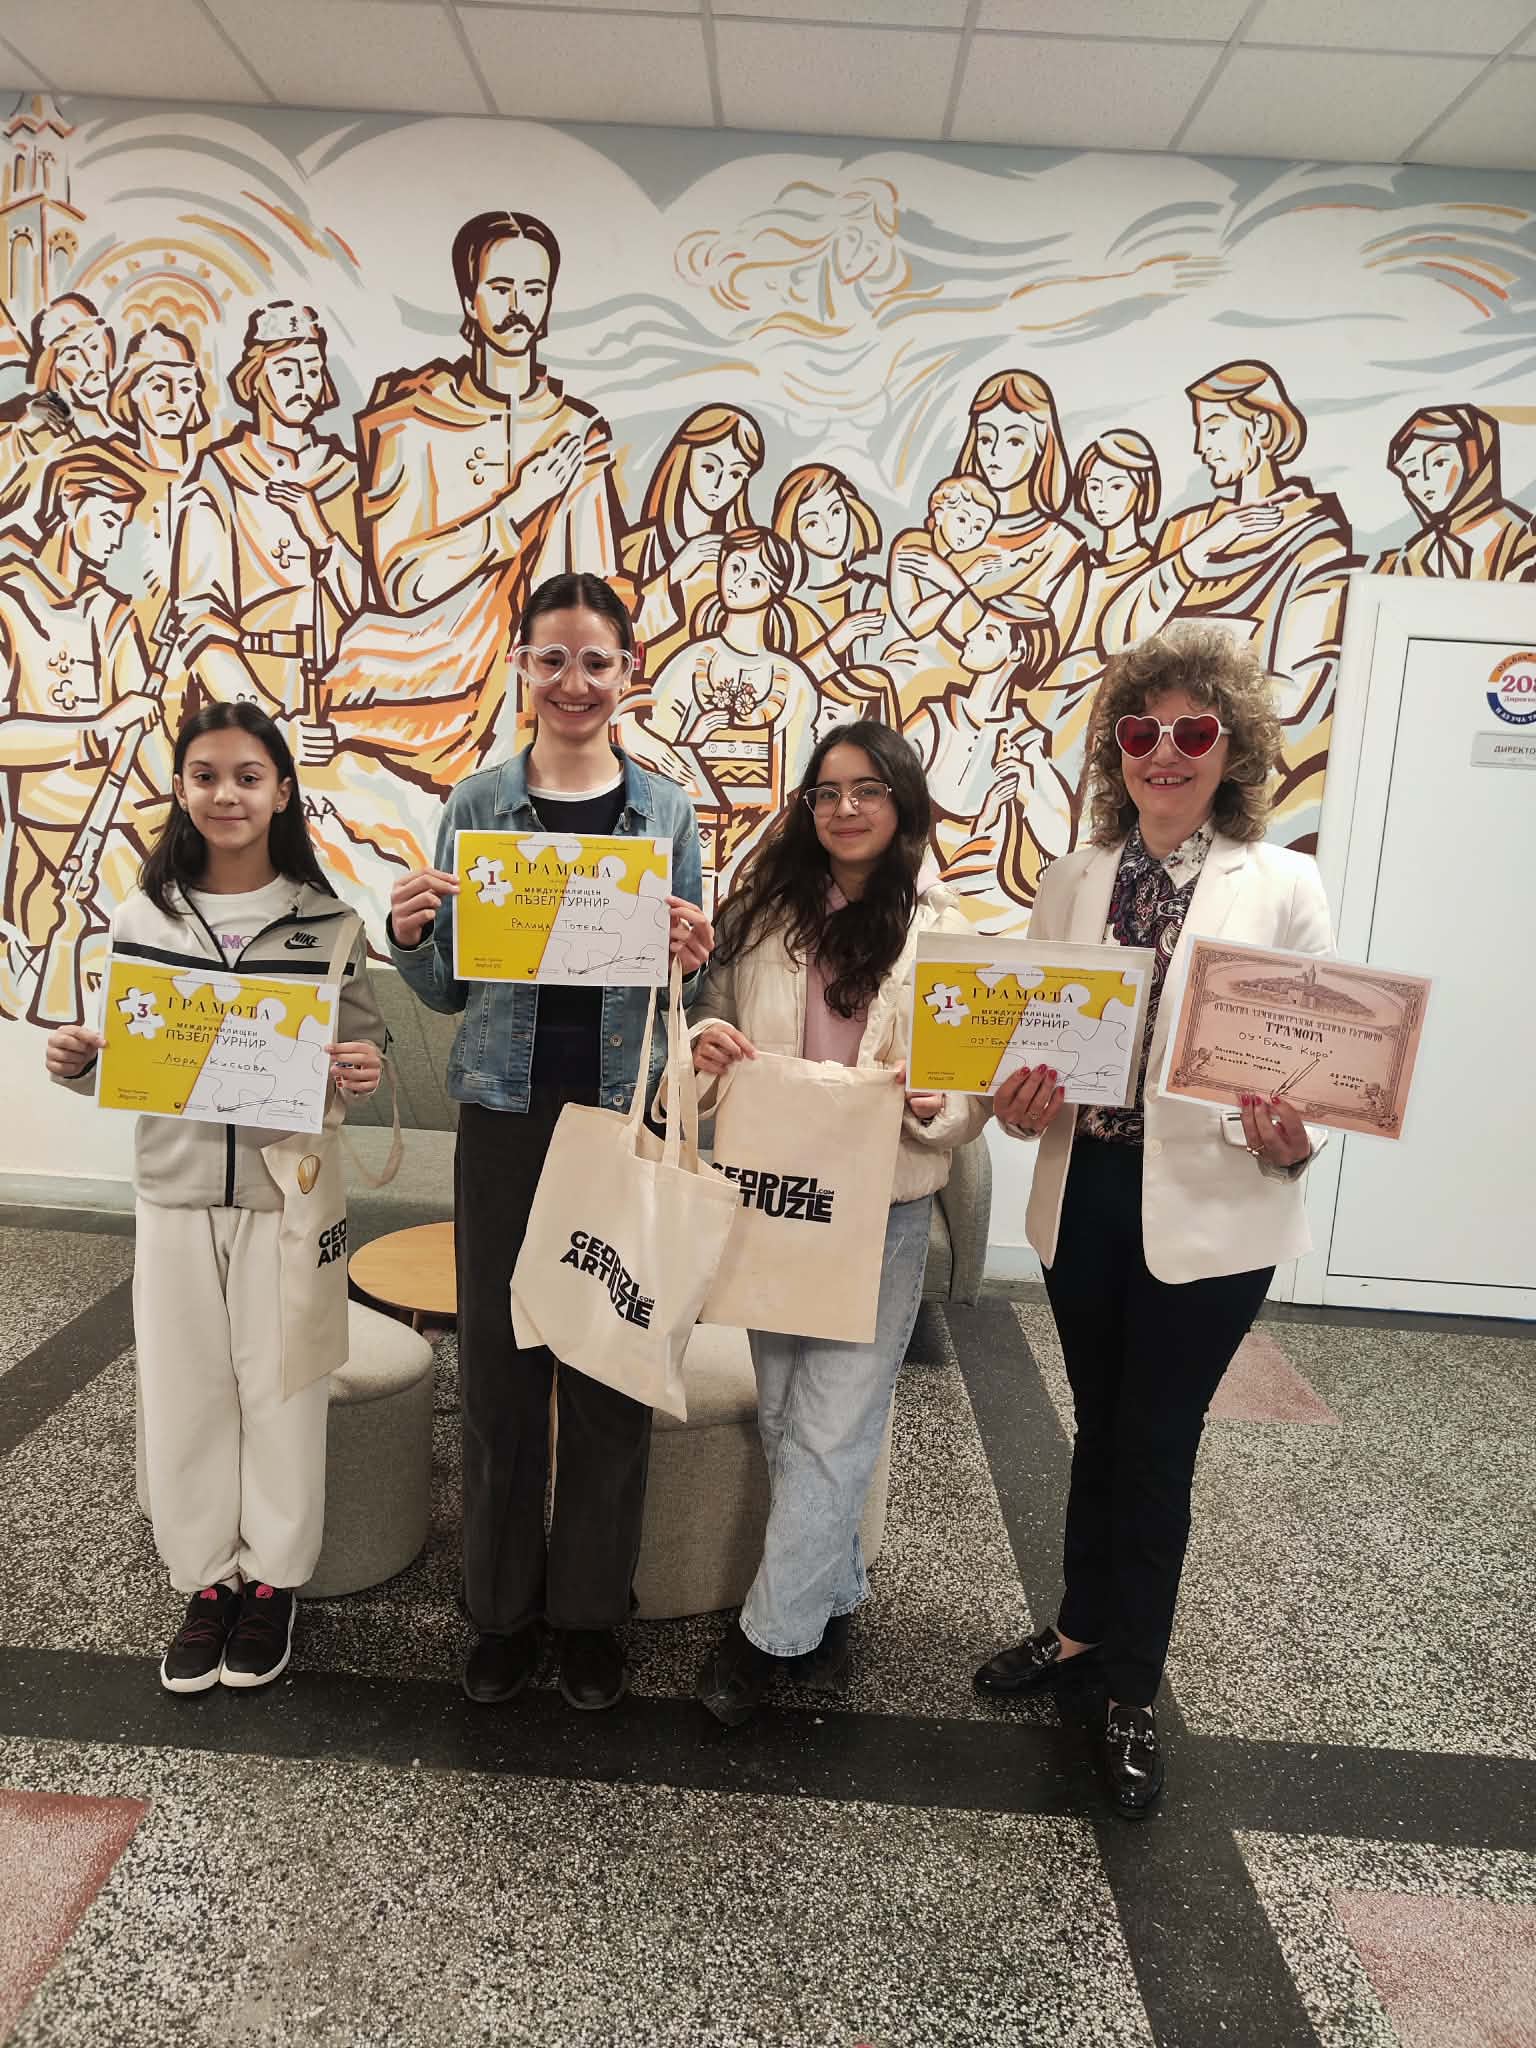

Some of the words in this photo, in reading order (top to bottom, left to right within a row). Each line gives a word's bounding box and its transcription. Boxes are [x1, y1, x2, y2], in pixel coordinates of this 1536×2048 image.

[513, 861, 612, 879] ГРАМОТА
[487, 871, 497, 885] 1
[515, 894, 557, 906] ПЪЗЕЛ
[559, 895, 610, 908] ТУРНИР
[291, 931, 319, 945] NIKE
[944, 995, 953, 1009] 1
[971, 987, 1074, 1004] ГРАМОТА
[137, 1002, 148, 1017] 3
[167, 996, 271, 1020] ГРАМОТА
[971, 1015, 1015, 1028] ПЪЗЕЛ
[1017, 1017, 1071, 1030] ТУРНИР
[166, 1029, 210, 1044] ПЪЗЕЛ
[214, 1034, 267, 1049] ТУРНИР
[1265, 1021, 1324, 1044] ГРАМОТА
